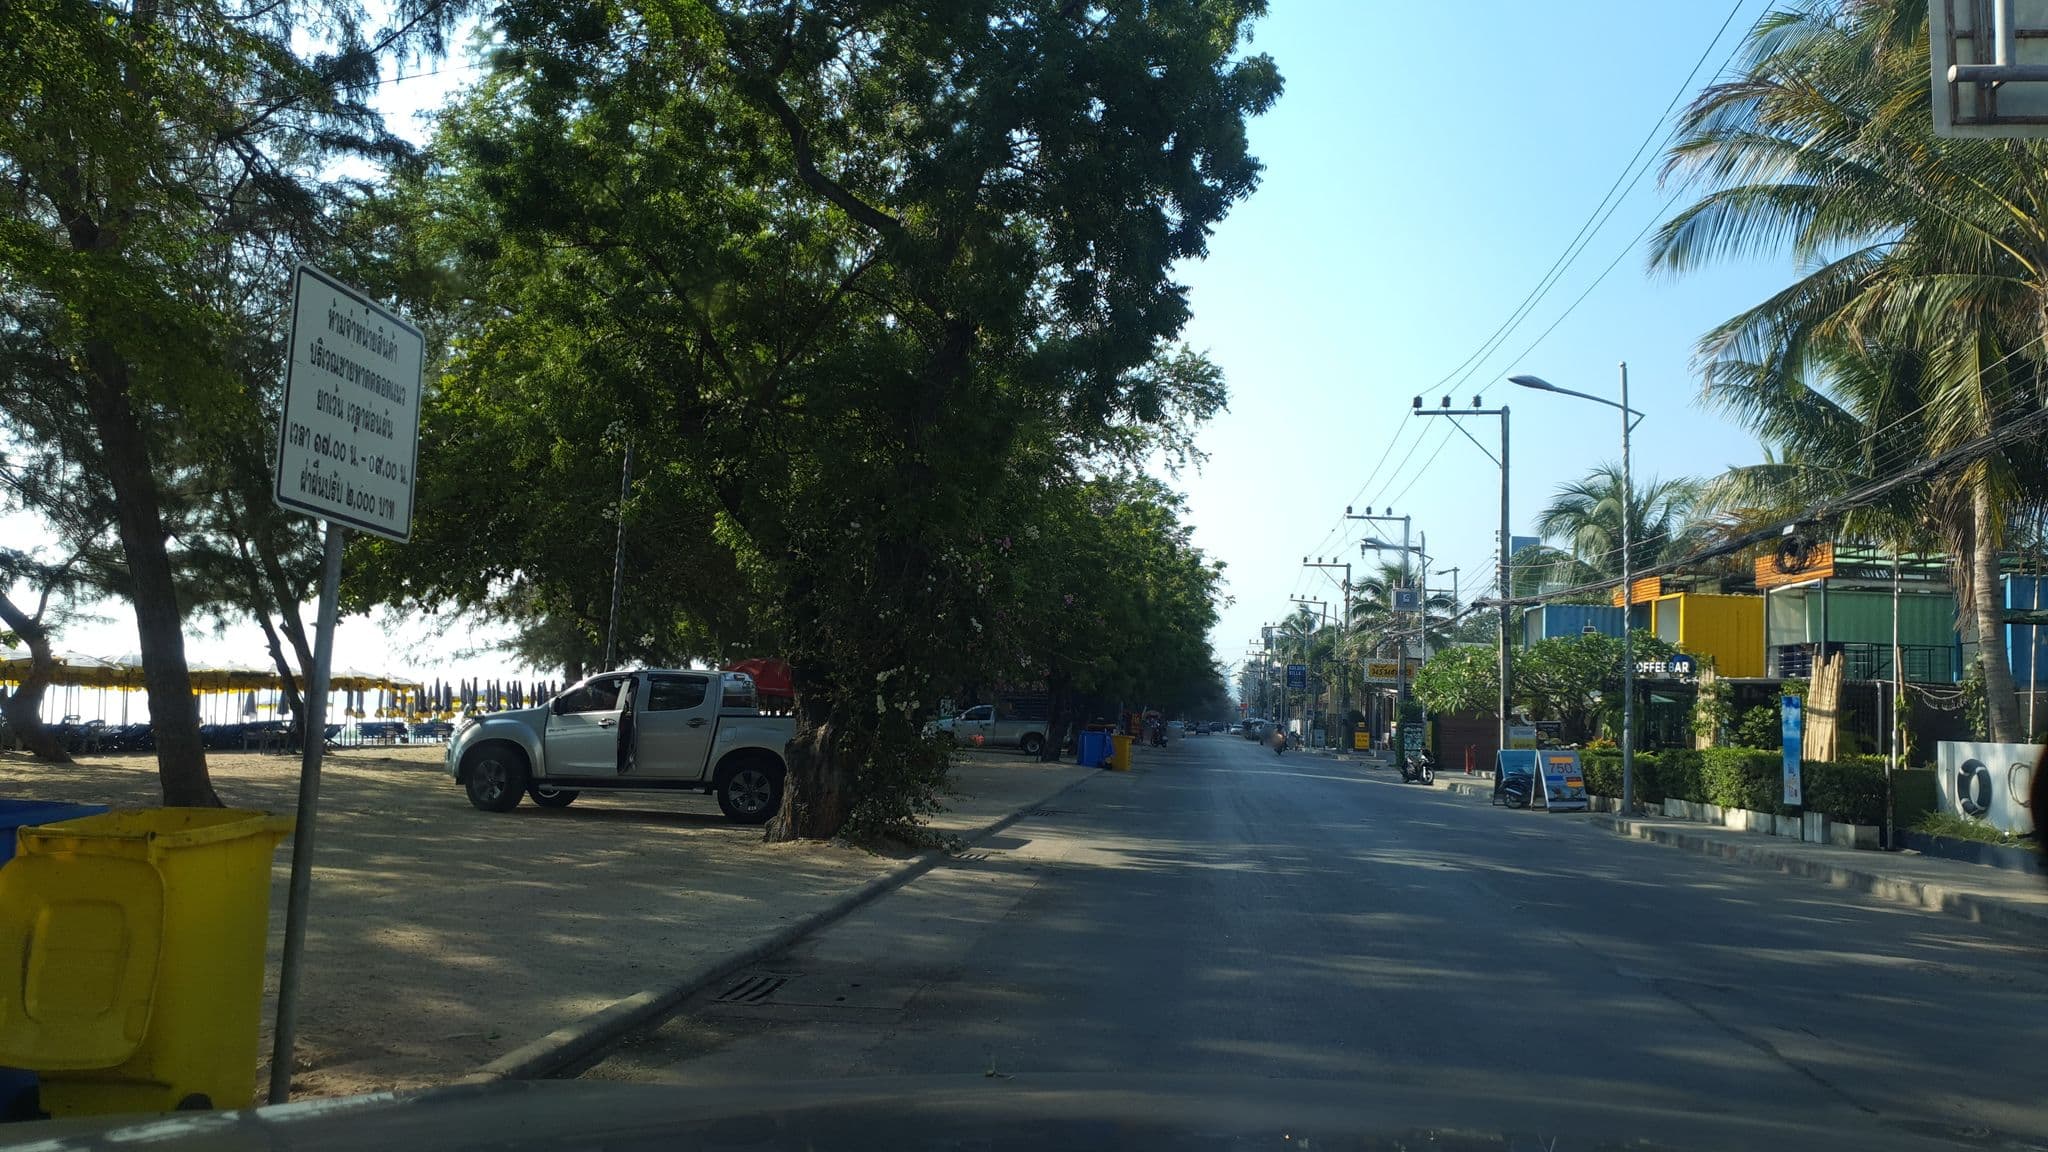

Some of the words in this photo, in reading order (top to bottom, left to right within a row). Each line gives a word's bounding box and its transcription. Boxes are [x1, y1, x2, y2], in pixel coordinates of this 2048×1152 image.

[316, 384, 344, 420] ยกเว้น
[289, 421, 311, 450] เวลา
[1668, 661, 1690, 673] BAR
